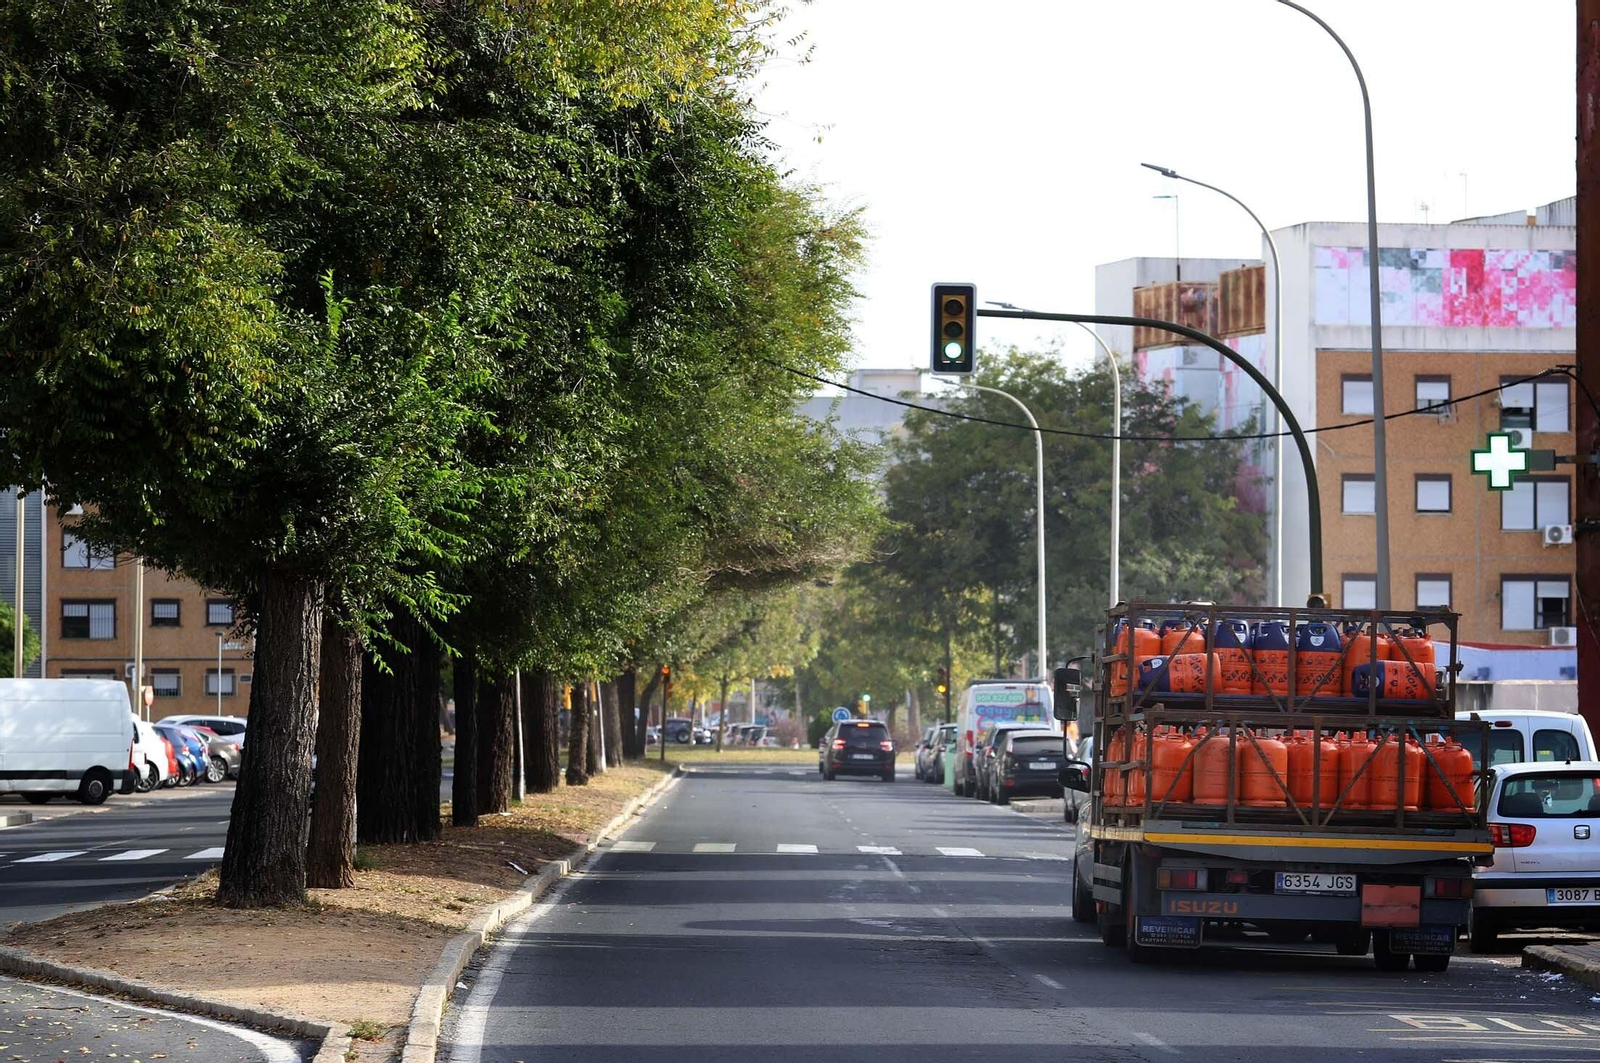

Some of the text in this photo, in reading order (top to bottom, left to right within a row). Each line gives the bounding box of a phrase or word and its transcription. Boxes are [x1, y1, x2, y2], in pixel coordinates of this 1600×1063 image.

[1284, 875, 1353, 889] 6354 JGS
[1557, 889, 1589, 901] 3087
[1170, 899, 1239, 915] ISUZU
[1142, 925, 1196, 935] REVEINCAR
[1388, 1014, 1600, 1035] BU
